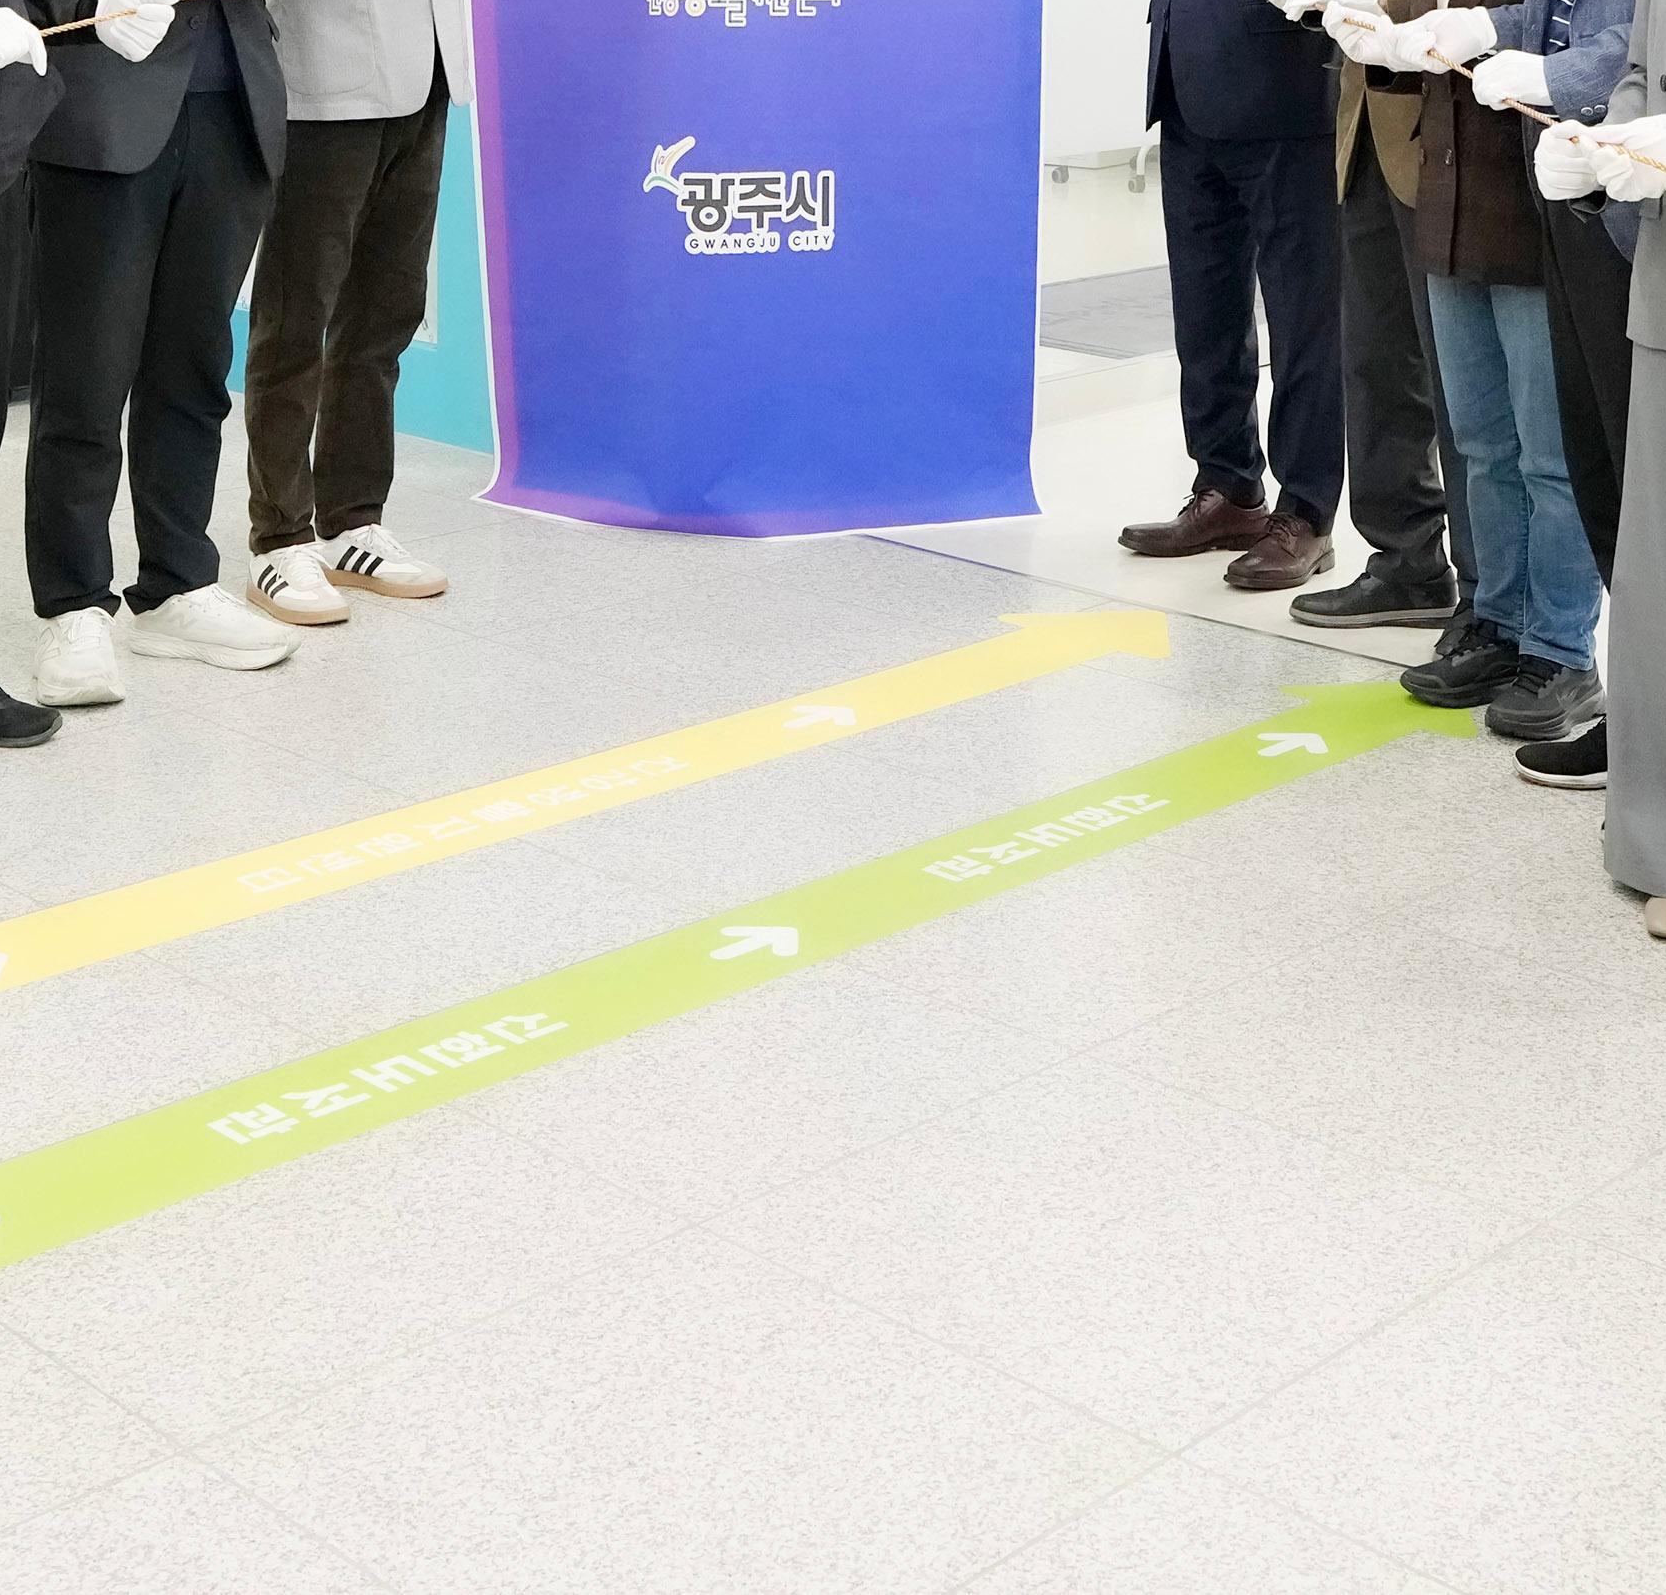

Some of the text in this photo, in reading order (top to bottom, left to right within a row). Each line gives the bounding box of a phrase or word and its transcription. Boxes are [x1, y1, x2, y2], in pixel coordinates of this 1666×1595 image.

[680, 175, 831, 233] 광주시
[689, 234, 831, 250] GWANGJU CITY
[919, 793, 1172, 882] 신현도서관
[205, 1011, 570, 1146] 신현도서관
